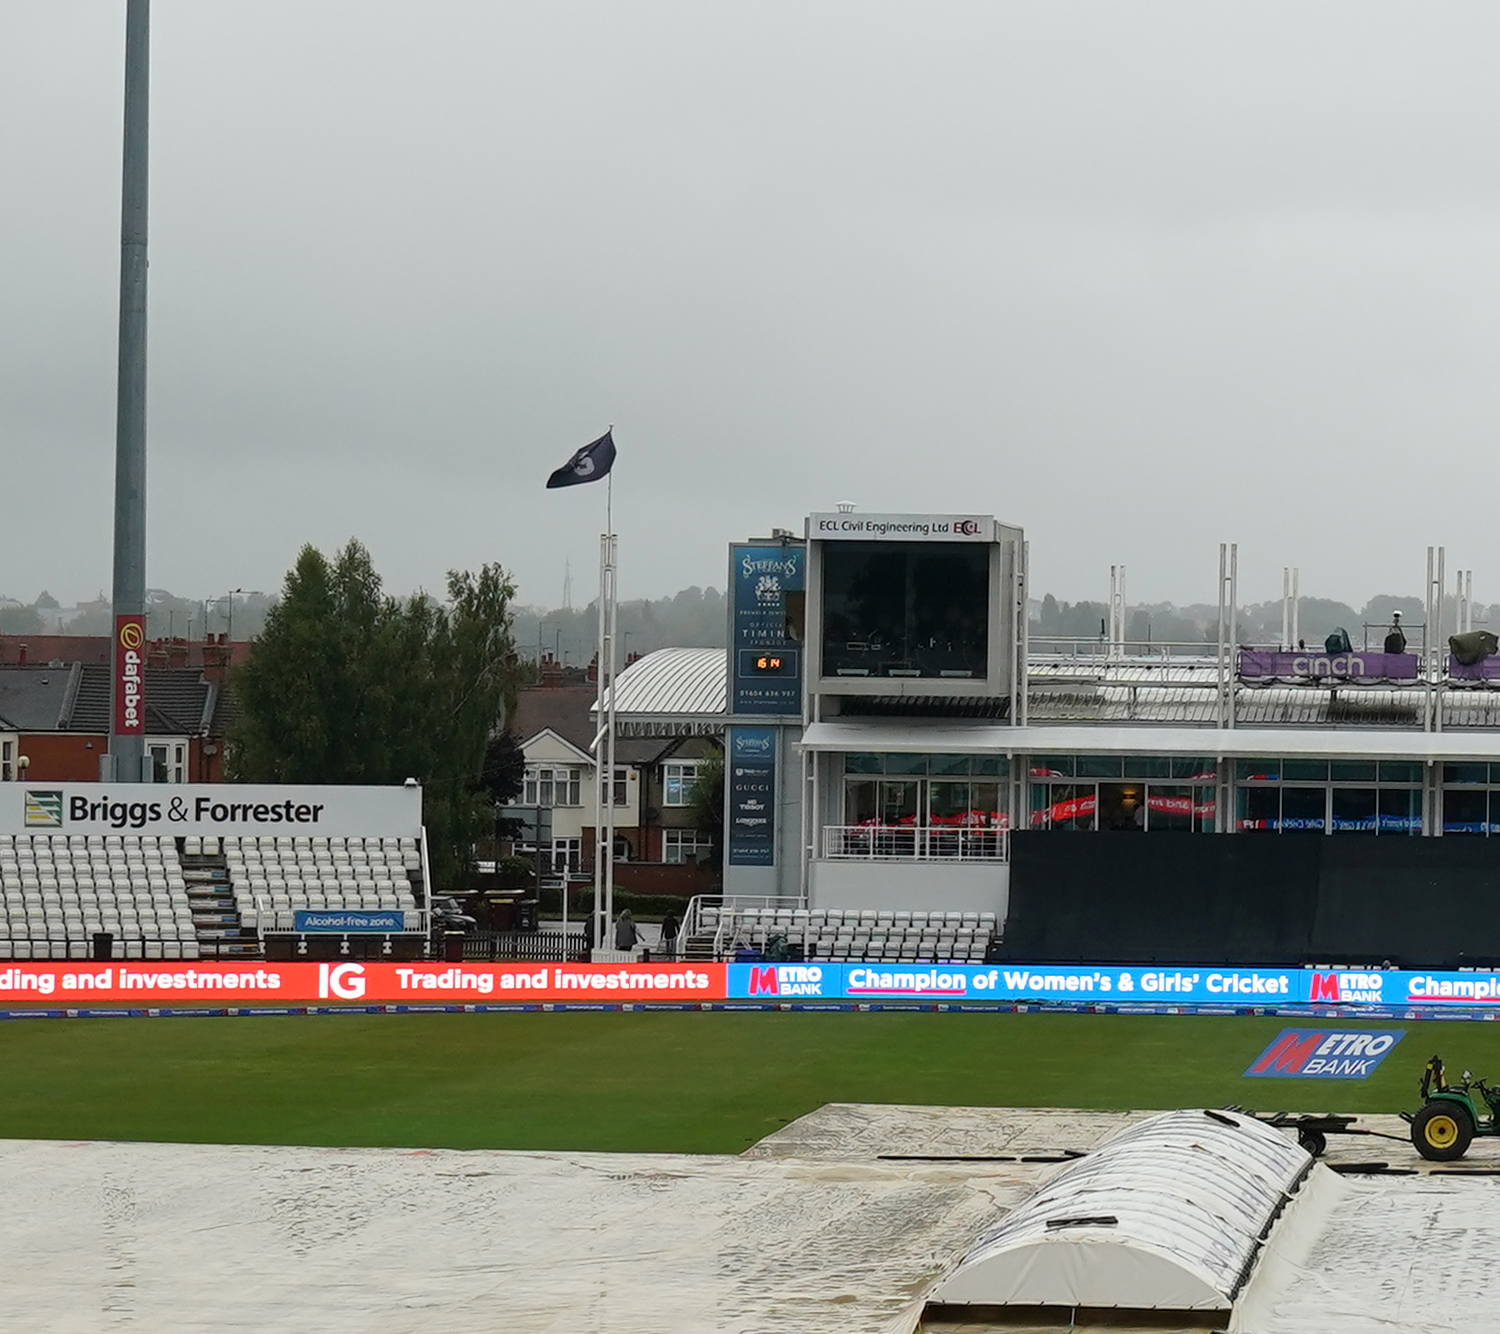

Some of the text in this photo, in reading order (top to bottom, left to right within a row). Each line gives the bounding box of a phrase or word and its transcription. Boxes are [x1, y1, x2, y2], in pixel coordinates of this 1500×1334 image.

[819, 520, 839, 531] ECL
[841, 520, 864, 531] Civil
[865, 521, 930, 536] Engineering
[932, 523, 949, 533] Ltd
[1292, 654, 1365, 676] cinch
[122, 650, 141, 727] dafabet
[70, 796, 323, 828] Briggs & Forrester
[305, 916, 395, 927] Alcohol-free zone
[61, 968, 113, 990] and
[119, 968, 281, 989] investments
[318, 964, 709, 998] IG Trading and investments
[779, 983, 823, 996] BANK
[847, 968, 1289, 996] Champion of Women's & Girls' Cricket
[1339, 989, 1383, 1003] BANK
[1301, 1059, 1376, 1076] BANK
